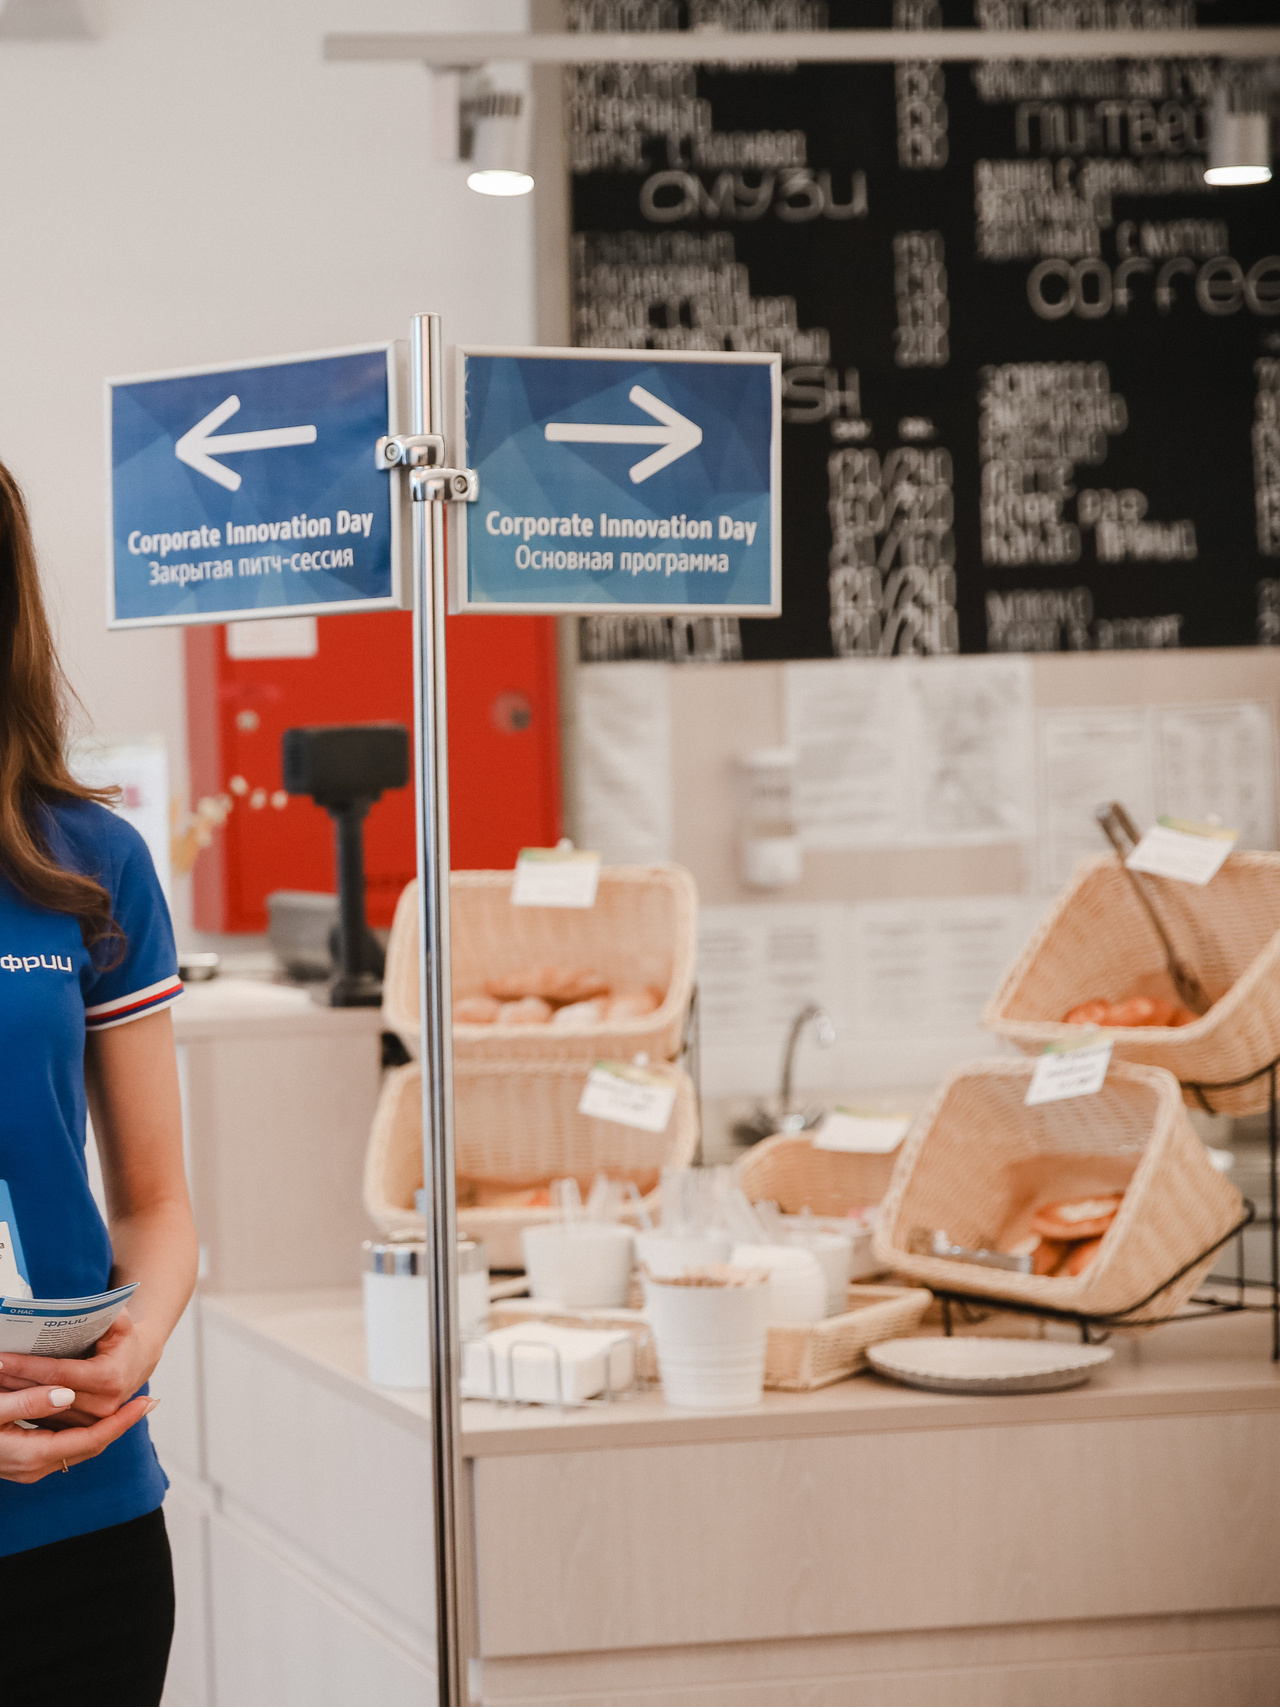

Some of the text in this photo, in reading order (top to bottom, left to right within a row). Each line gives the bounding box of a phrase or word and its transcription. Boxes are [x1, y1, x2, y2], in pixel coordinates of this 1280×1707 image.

[127, 509, 374, 557] Corporate Innovation Day
[485, 510, 757, 546] Corporate Innovation Day
[148, 547, 354, 587] Закрытая питч-сессия
[515, 544, 730, 577] Основная программа
